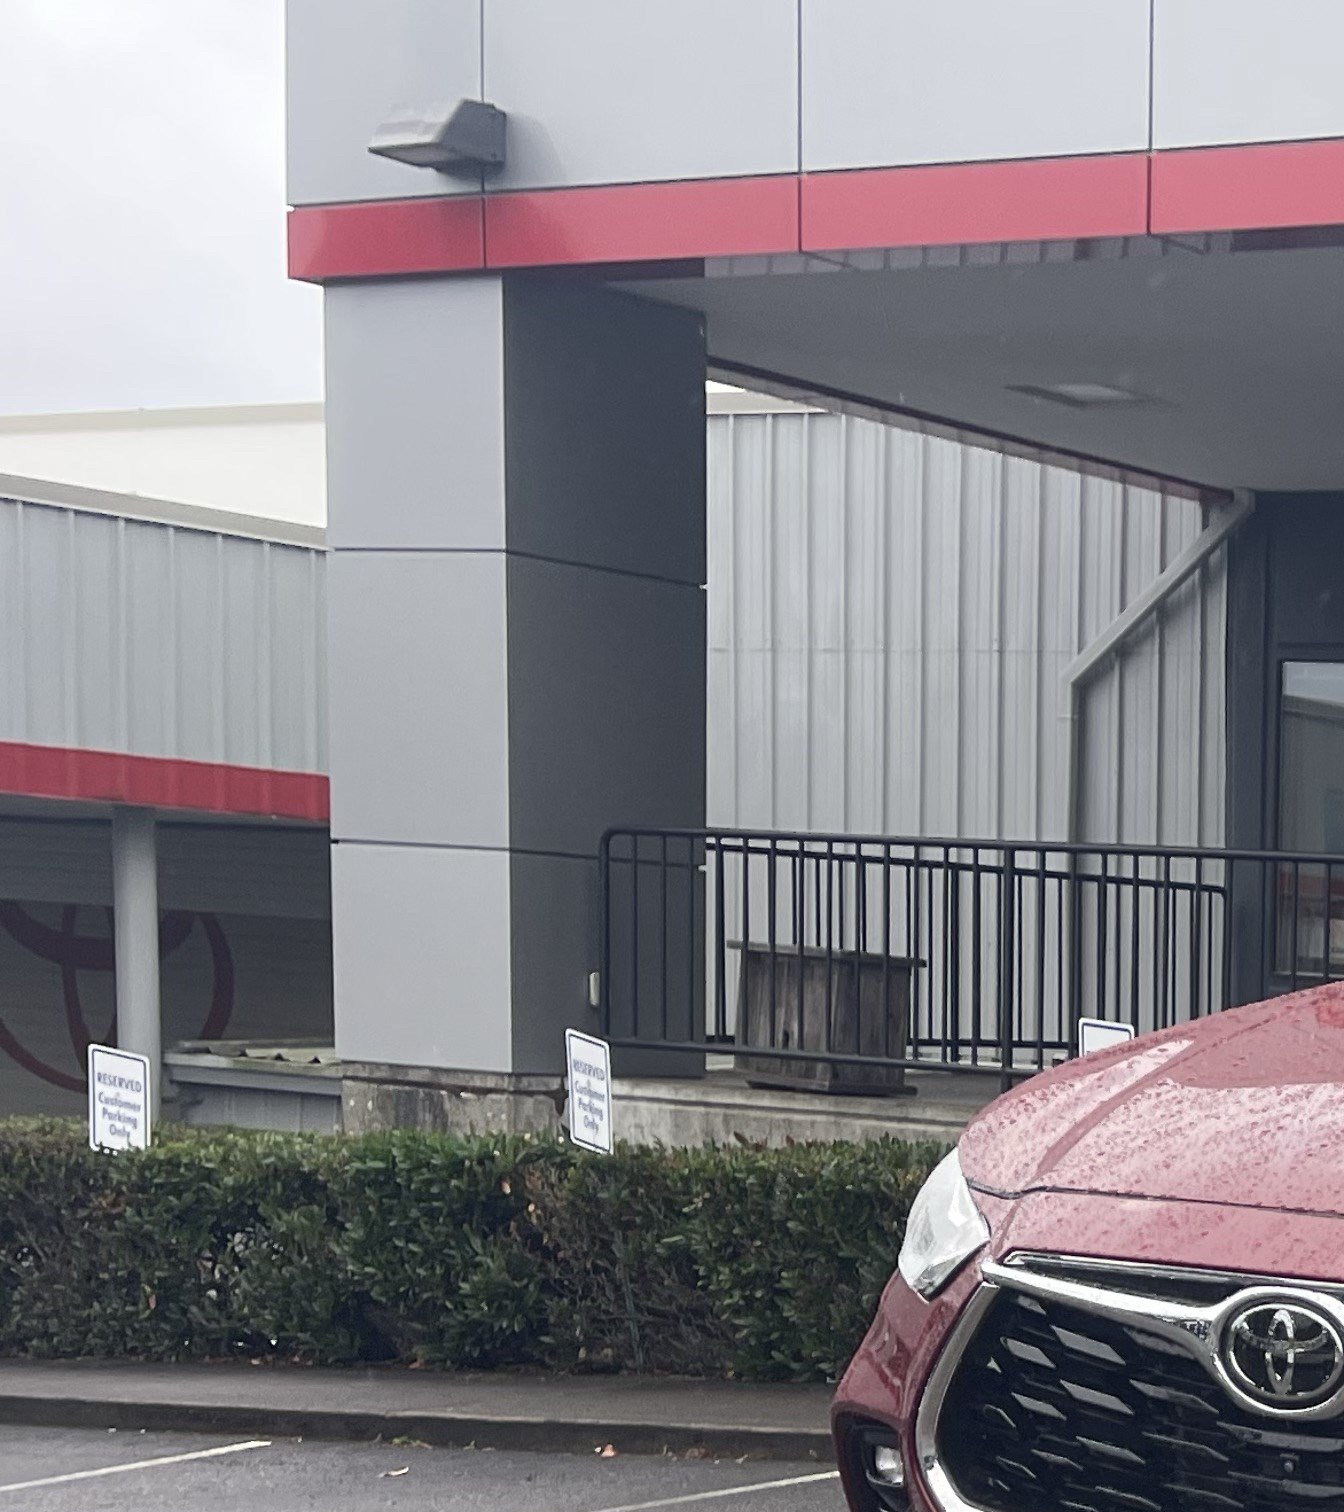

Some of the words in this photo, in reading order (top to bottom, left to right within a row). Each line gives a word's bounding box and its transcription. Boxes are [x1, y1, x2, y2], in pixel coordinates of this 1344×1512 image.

[97, 1072, 142, 1093] RESERVED
[98, 1091, 141, 1112] Customer
[102, 1106, 138, 1129] Parking
[109, 1123, 131, 1139] Only
